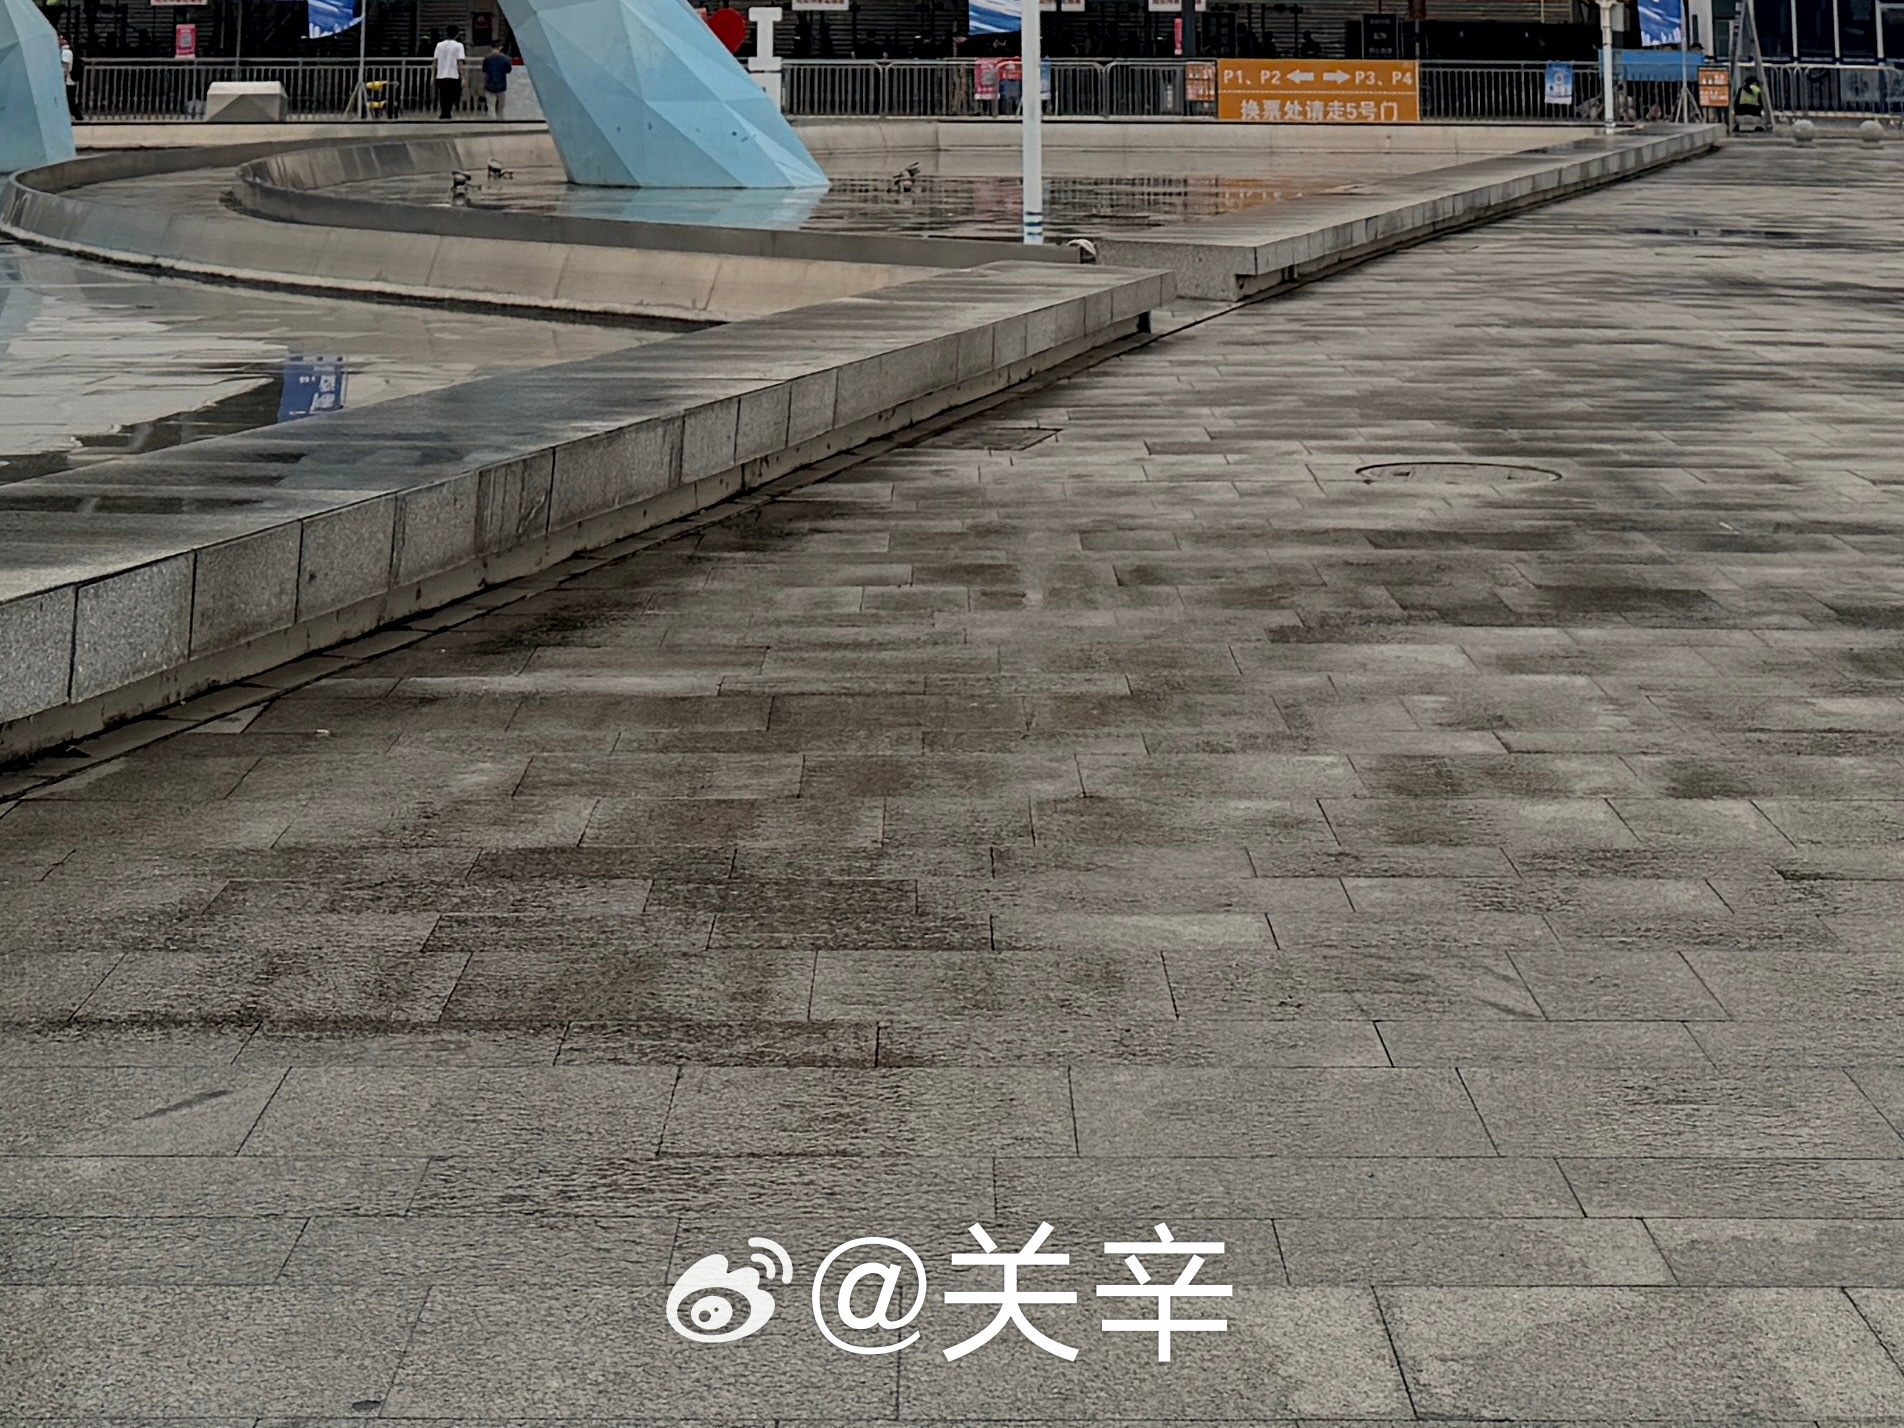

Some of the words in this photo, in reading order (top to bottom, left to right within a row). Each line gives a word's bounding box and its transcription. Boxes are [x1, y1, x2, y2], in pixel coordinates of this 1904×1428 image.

[1223, 70, 1282, 85] P1、P2
[1355, 70, 1413, 87] P3、P4
[1240, 99, 1398, 122] 换票处请走5号门
